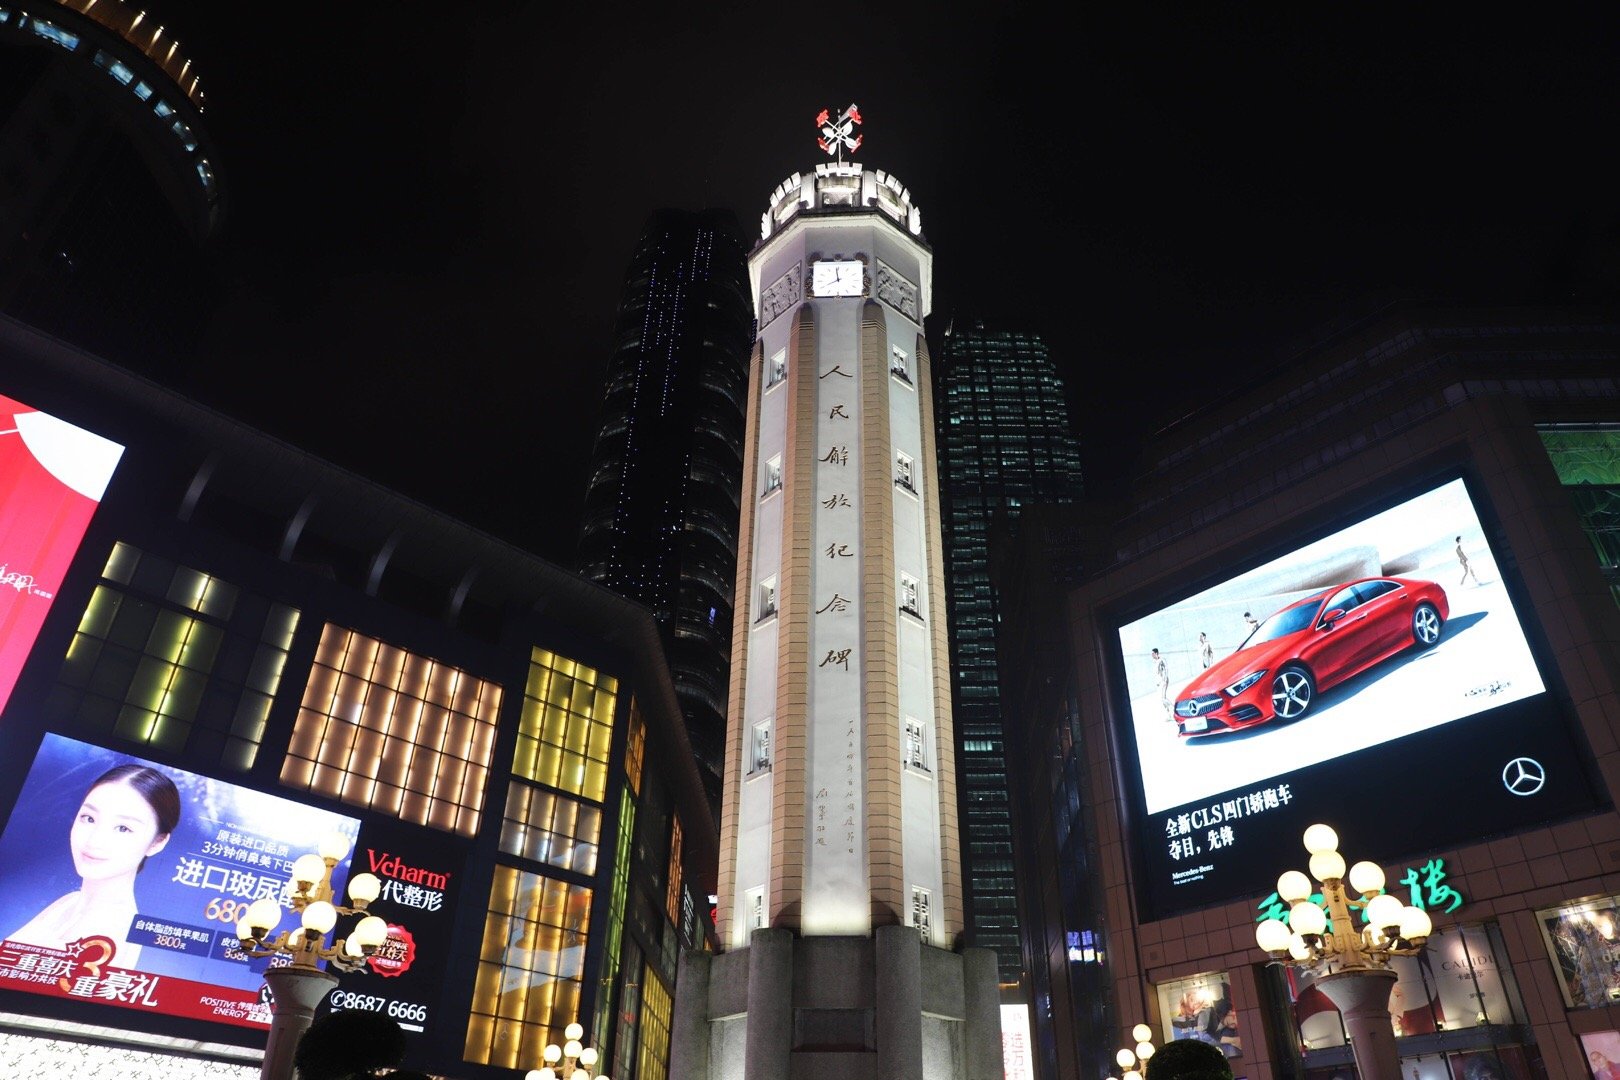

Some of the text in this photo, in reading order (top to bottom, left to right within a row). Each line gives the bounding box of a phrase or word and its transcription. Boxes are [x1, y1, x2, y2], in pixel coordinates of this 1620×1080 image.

[1165, 784, 1293, 838] 全新CLS四门轿跑车
[216, 829, 289, 858] 原装进口品质
[367, 848, 446, 890] Vcharm
[1172, 864, 1214, 880] Mercedes-Benz
[378, 878, 443, 912] 代整形
[154, 934, 186, 950] 3800元
[0, 950, 78, 978] 三重喜庆
[200, 996, 237, 1010] POSITIVE
[213, 1006, 247, 1019] ENERGY
[344, 992, 427, 1022] 8687 6666
